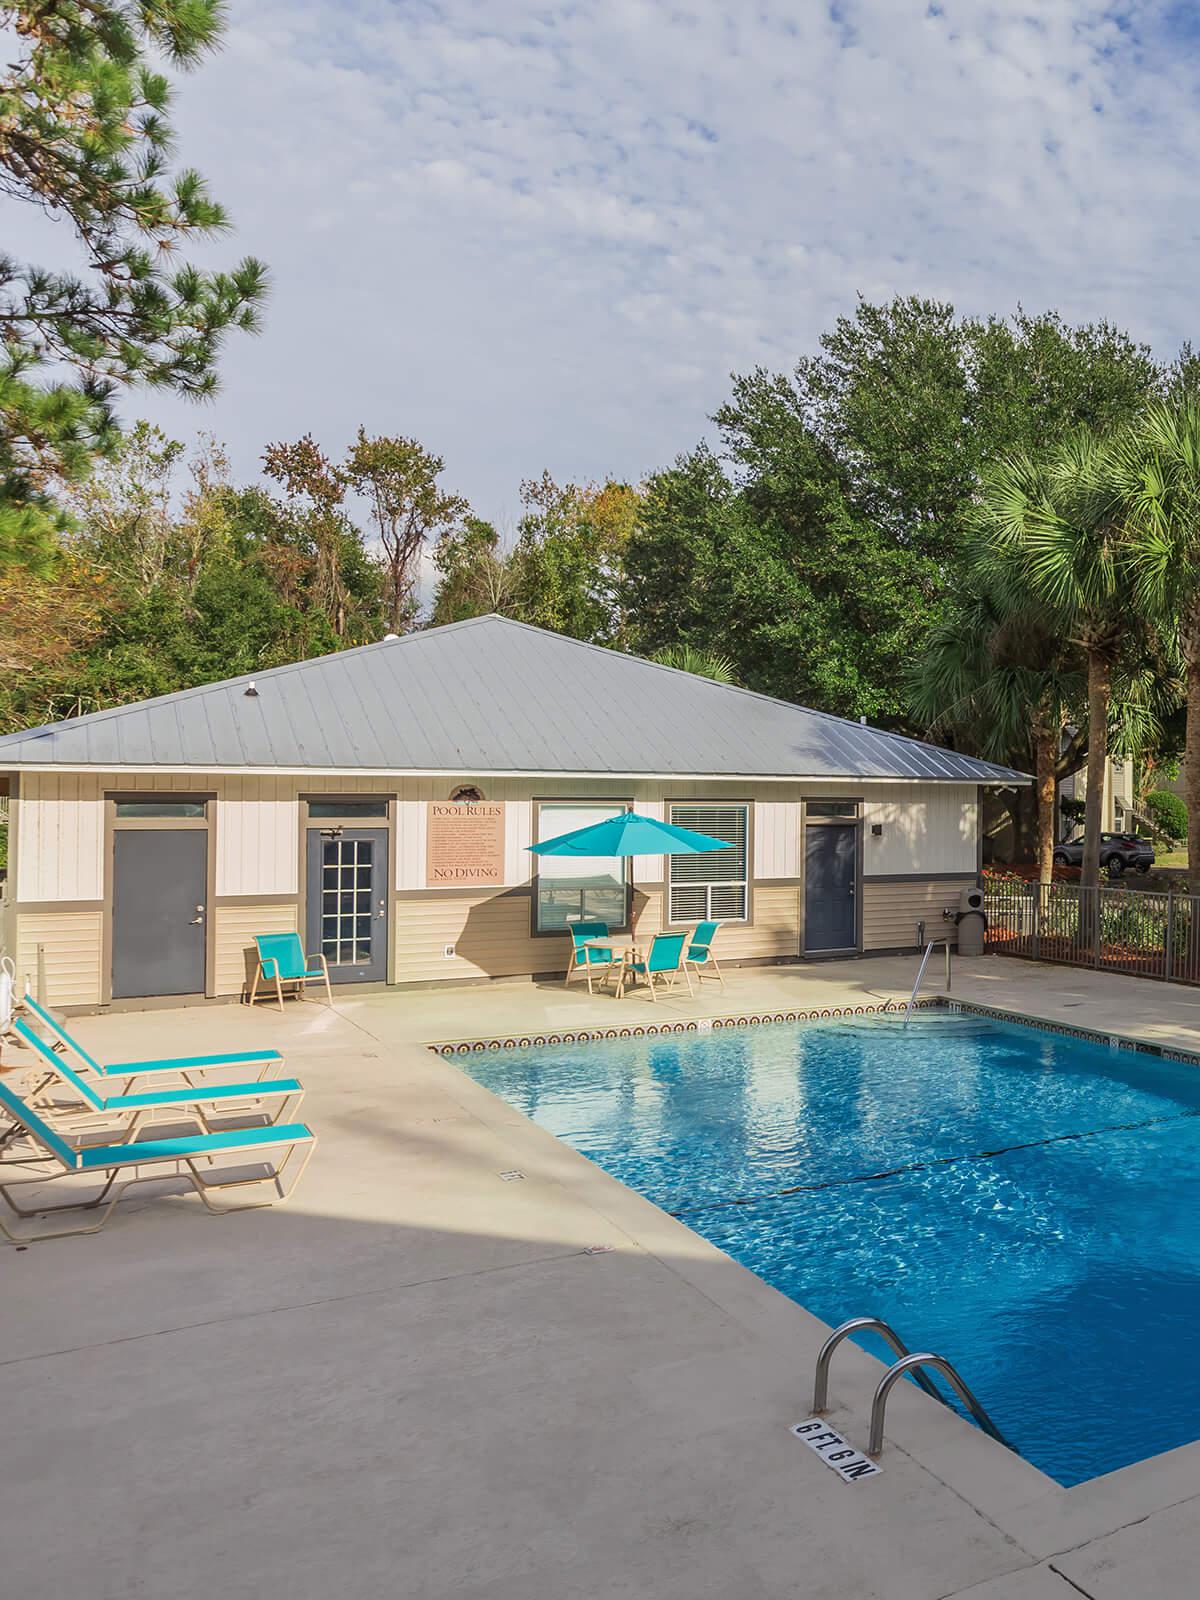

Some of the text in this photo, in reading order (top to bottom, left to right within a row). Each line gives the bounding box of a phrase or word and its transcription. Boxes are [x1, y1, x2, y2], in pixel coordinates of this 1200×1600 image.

[433, 806, 501, 816] POOL RULES
[434, 867, 498, 878] NO DIVING
[796, 1423, 822, 1434] 6
[828, 1449, 855, 1461] 6
